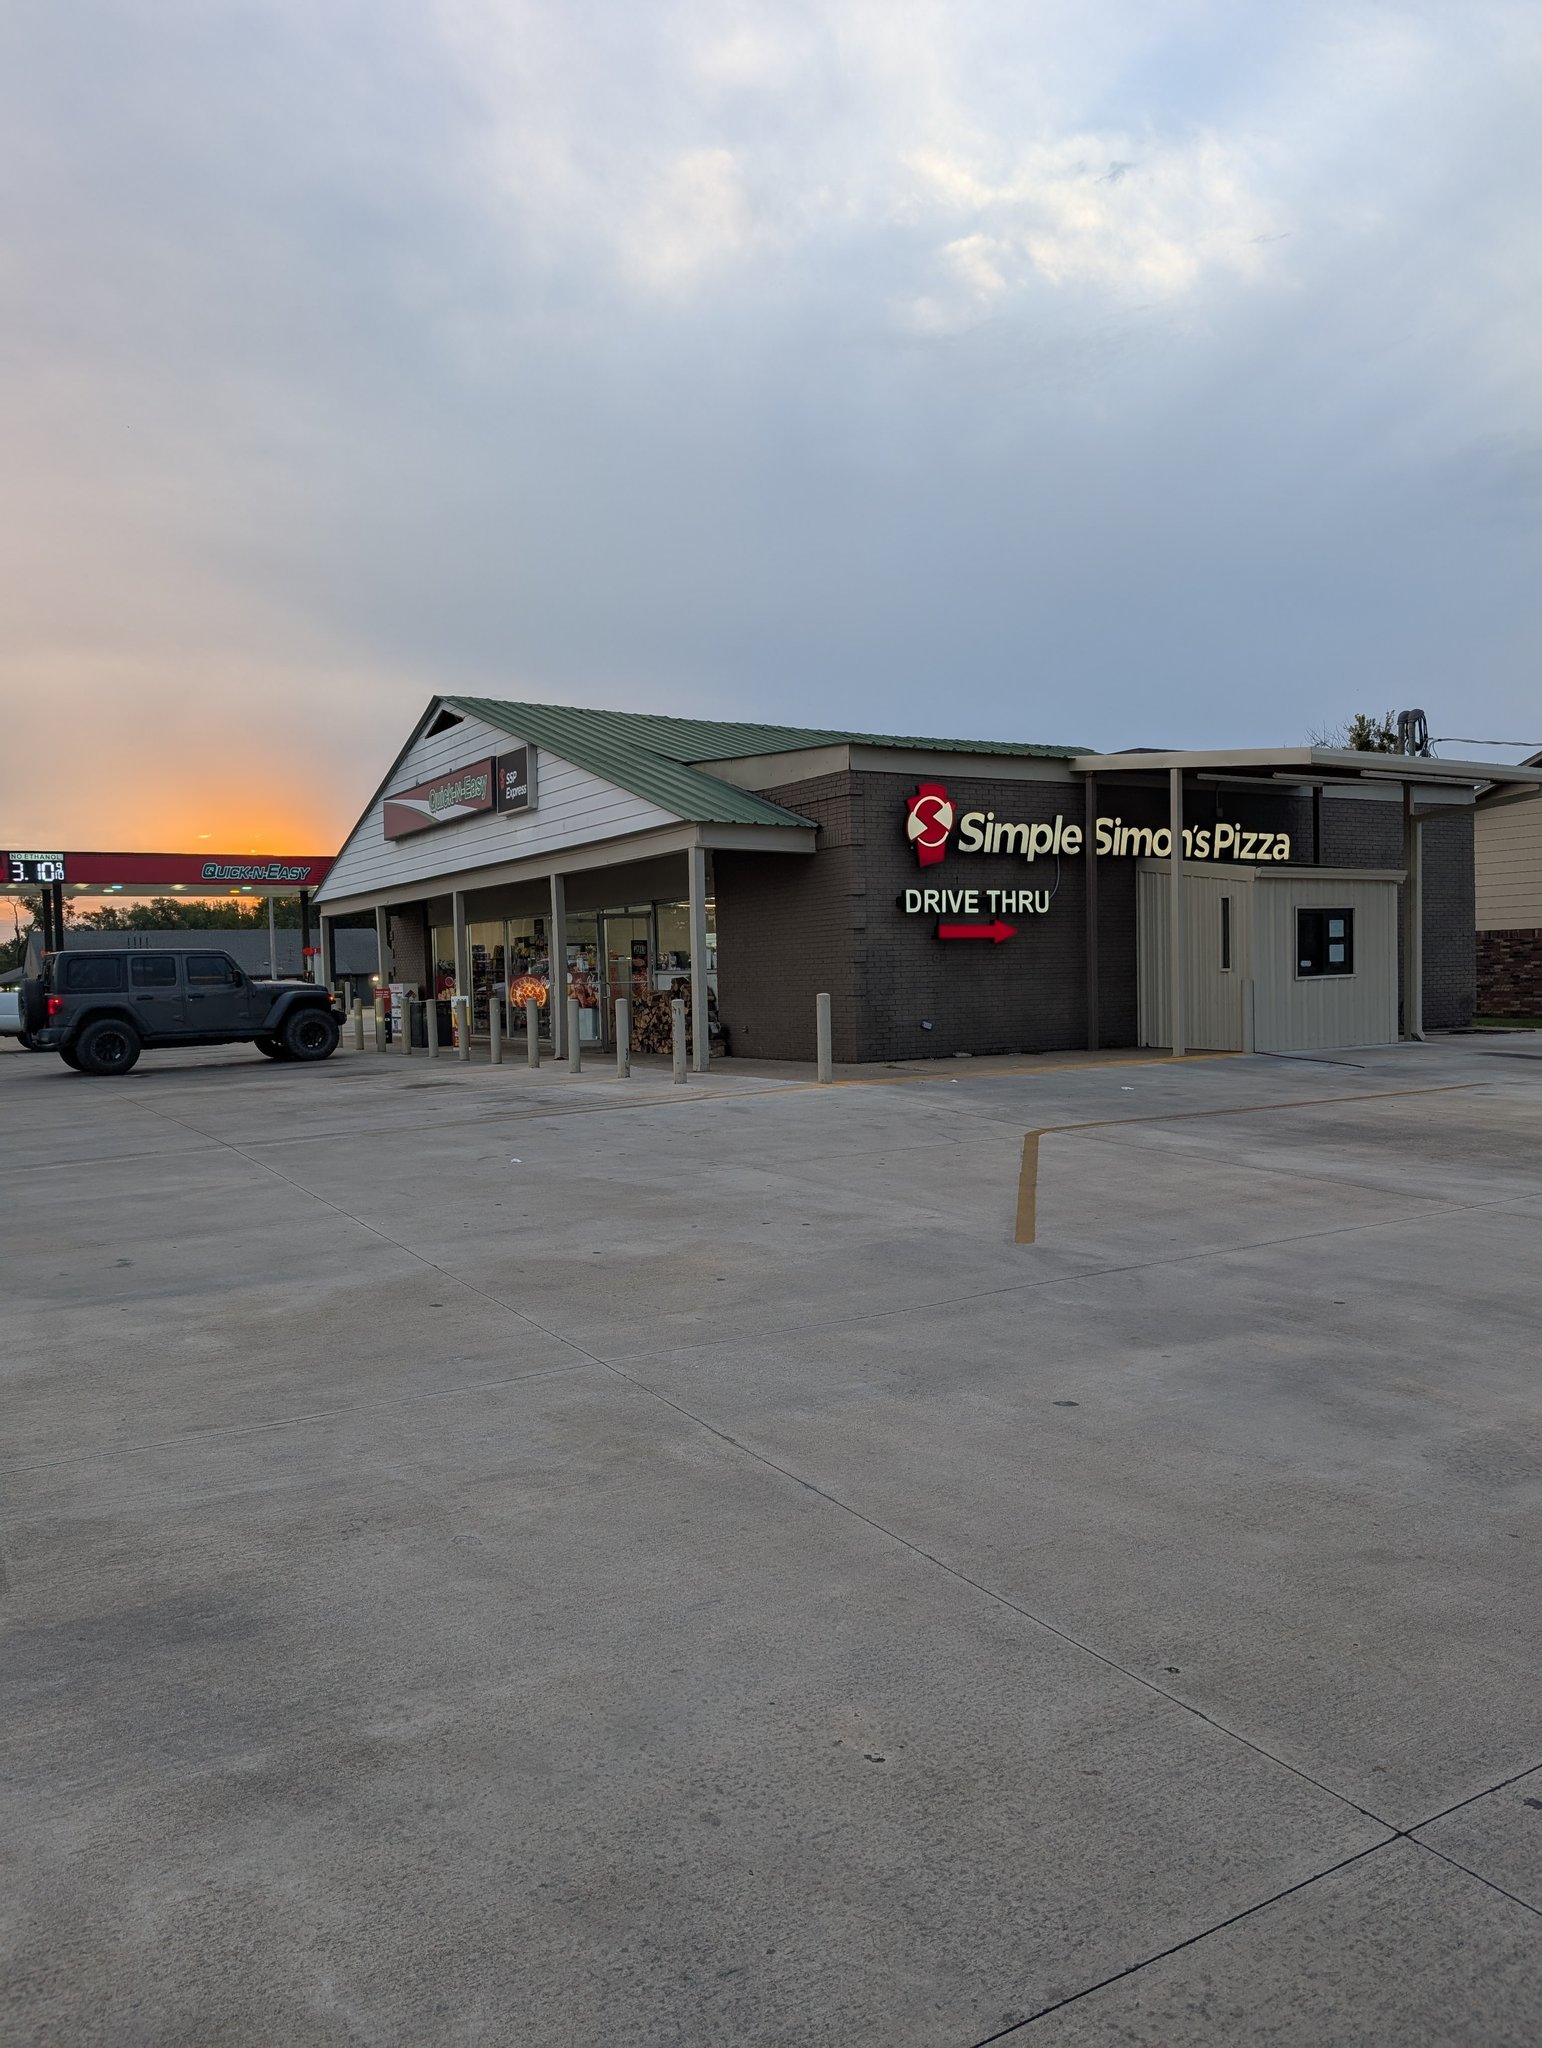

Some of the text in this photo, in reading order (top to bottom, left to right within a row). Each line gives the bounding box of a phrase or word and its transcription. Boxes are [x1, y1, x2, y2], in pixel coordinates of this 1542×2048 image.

[506, 785, 526, 799] Express
[958, 811, 1291, 862] Simple Simon's Pizza
[905, 889, 1050, 914] DRIVE THRU
